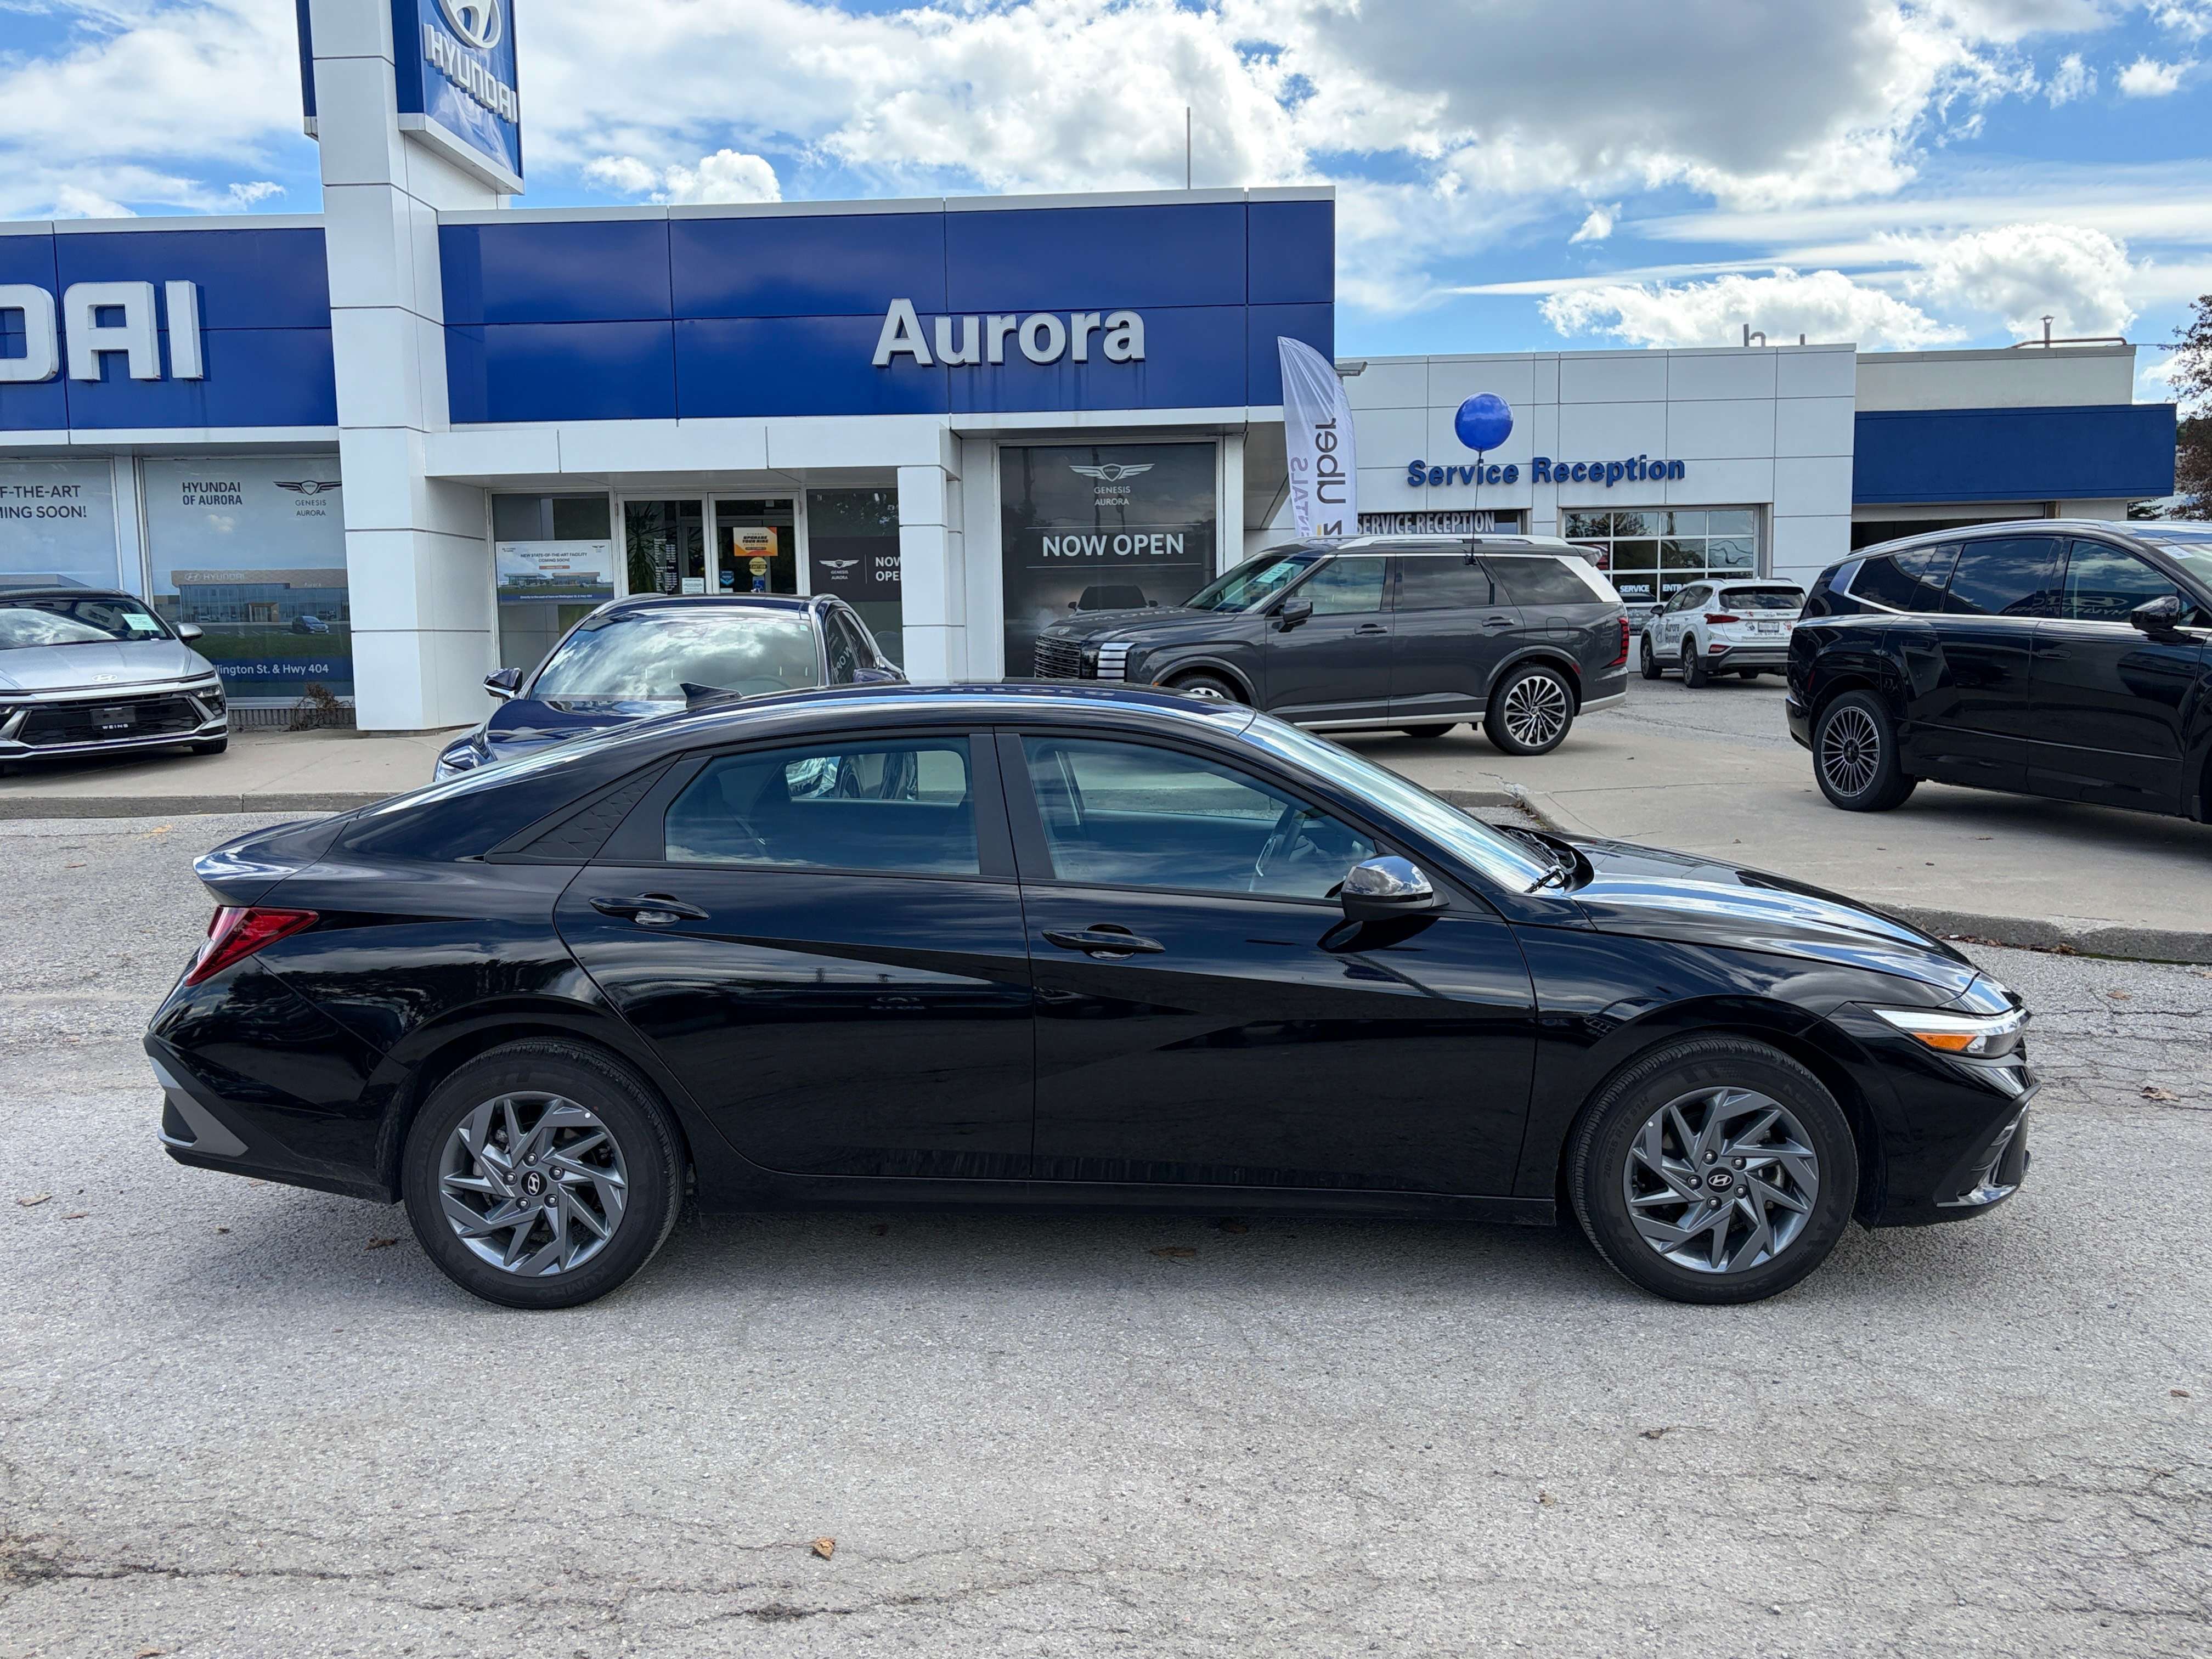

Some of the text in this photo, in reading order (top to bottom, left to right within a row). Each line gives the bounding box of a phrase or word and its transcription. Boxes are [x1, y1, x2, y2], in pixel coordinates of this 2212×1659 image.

[423, 24, 518, 123] HYUNDAI
[872, 298, 1146, 366] Aurora
[1407, 454, 1685, 488] Service Reception
[182, 482, 241, 493] HYUNDAI
[183, 495, 242, 505] OF AURORA
[1094, 498, 1130, 506] AURORA
[0, 505, 87, 518] ING SOON!
[1357, 514, 1413, 535] SERVICE
[1416, 511, 1496, 534] RECEPTION
[1043, 533, 1184, 557] NOW OPEN
[1620, 584, 1650, 593] SERVICE
[257, 664, 270, 674] St.
[272, 664, 280, 674] &
[283, 664, 306, 675] Hwy
[308, 664, 329, 673] 404
